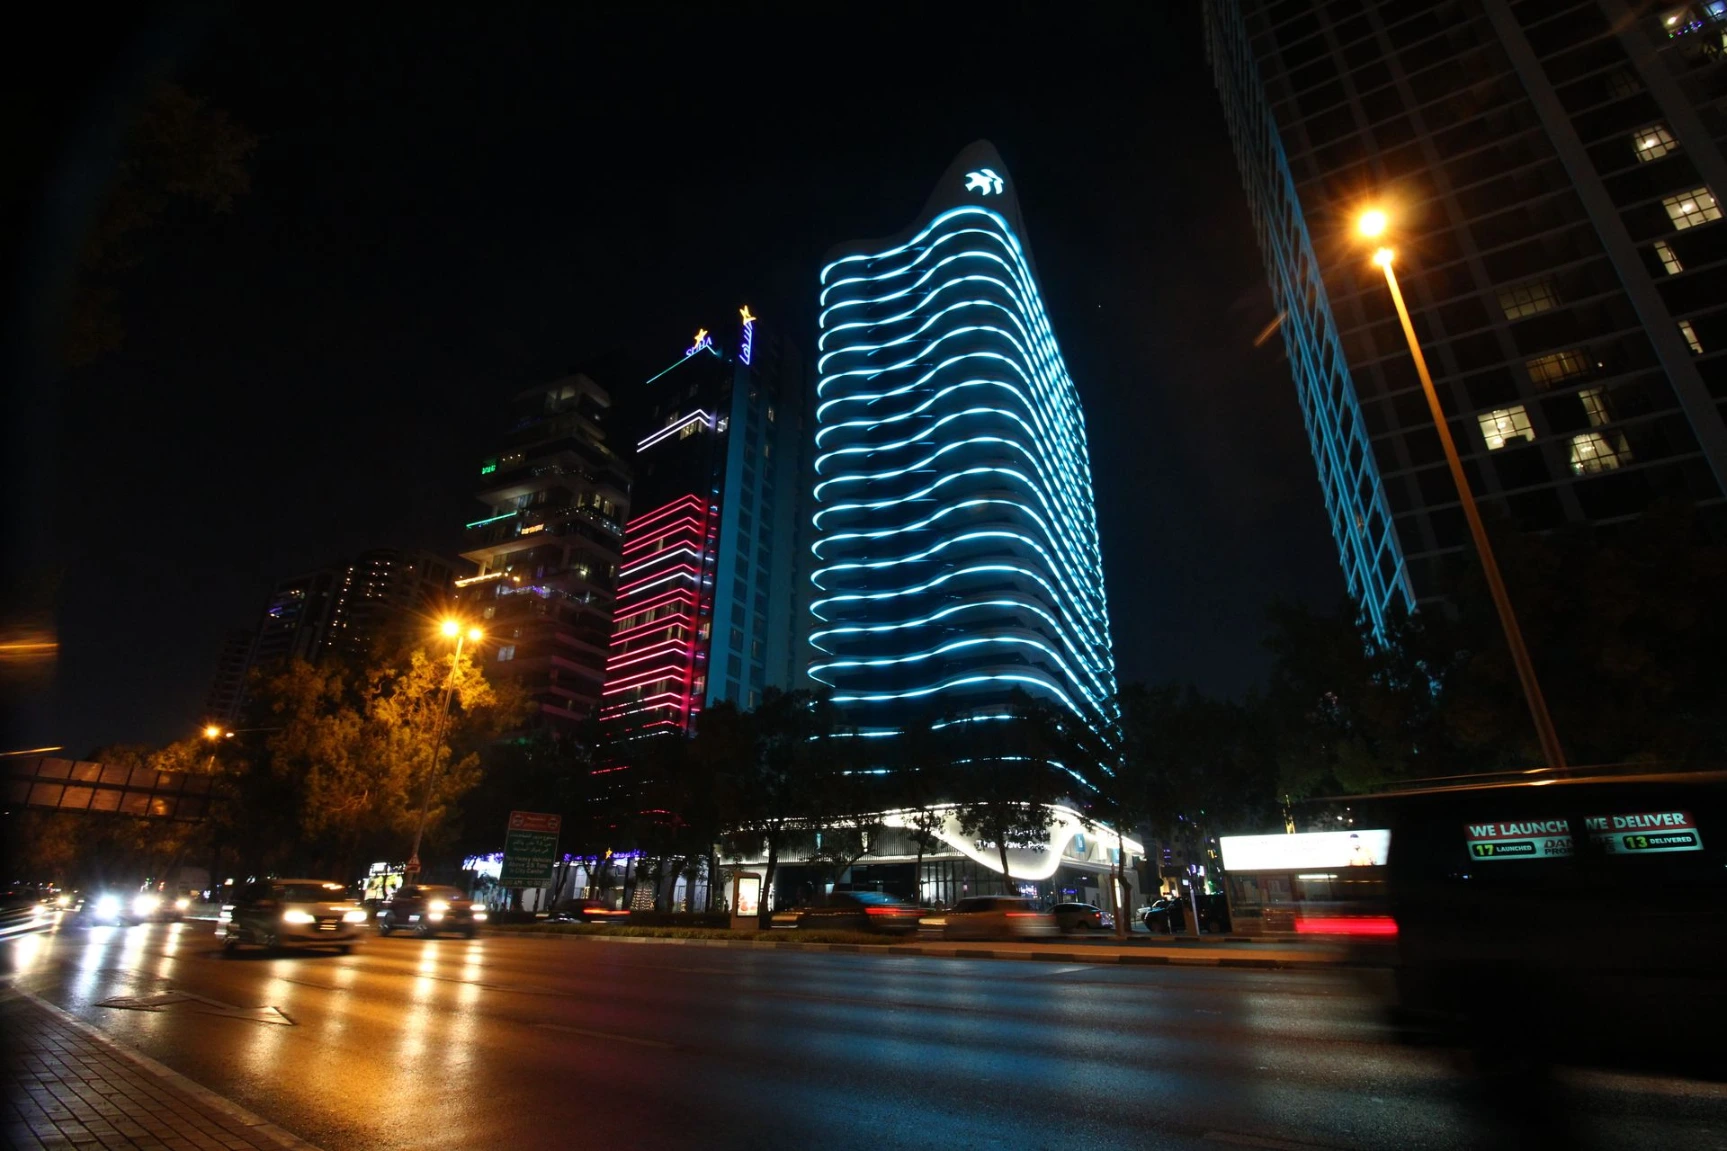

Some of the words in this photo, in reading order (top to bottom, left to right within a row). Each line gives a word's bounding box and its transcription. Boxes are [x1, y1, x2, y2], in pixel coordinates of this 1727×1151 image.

[1612, 812, 1687, 829] DELIVER
[1469, 824, 1496, 837] WE
[1499, 820, 1570, 836] LAUNCH
[976, 840, 996, 849] The
[1626, 836, 1648, 848] 13
[1649, 836, 1692, 845] DELIVERED
[1476, 844, 1494, 856] 17
[1496, 845, 1532, 853] LAUNCHED
